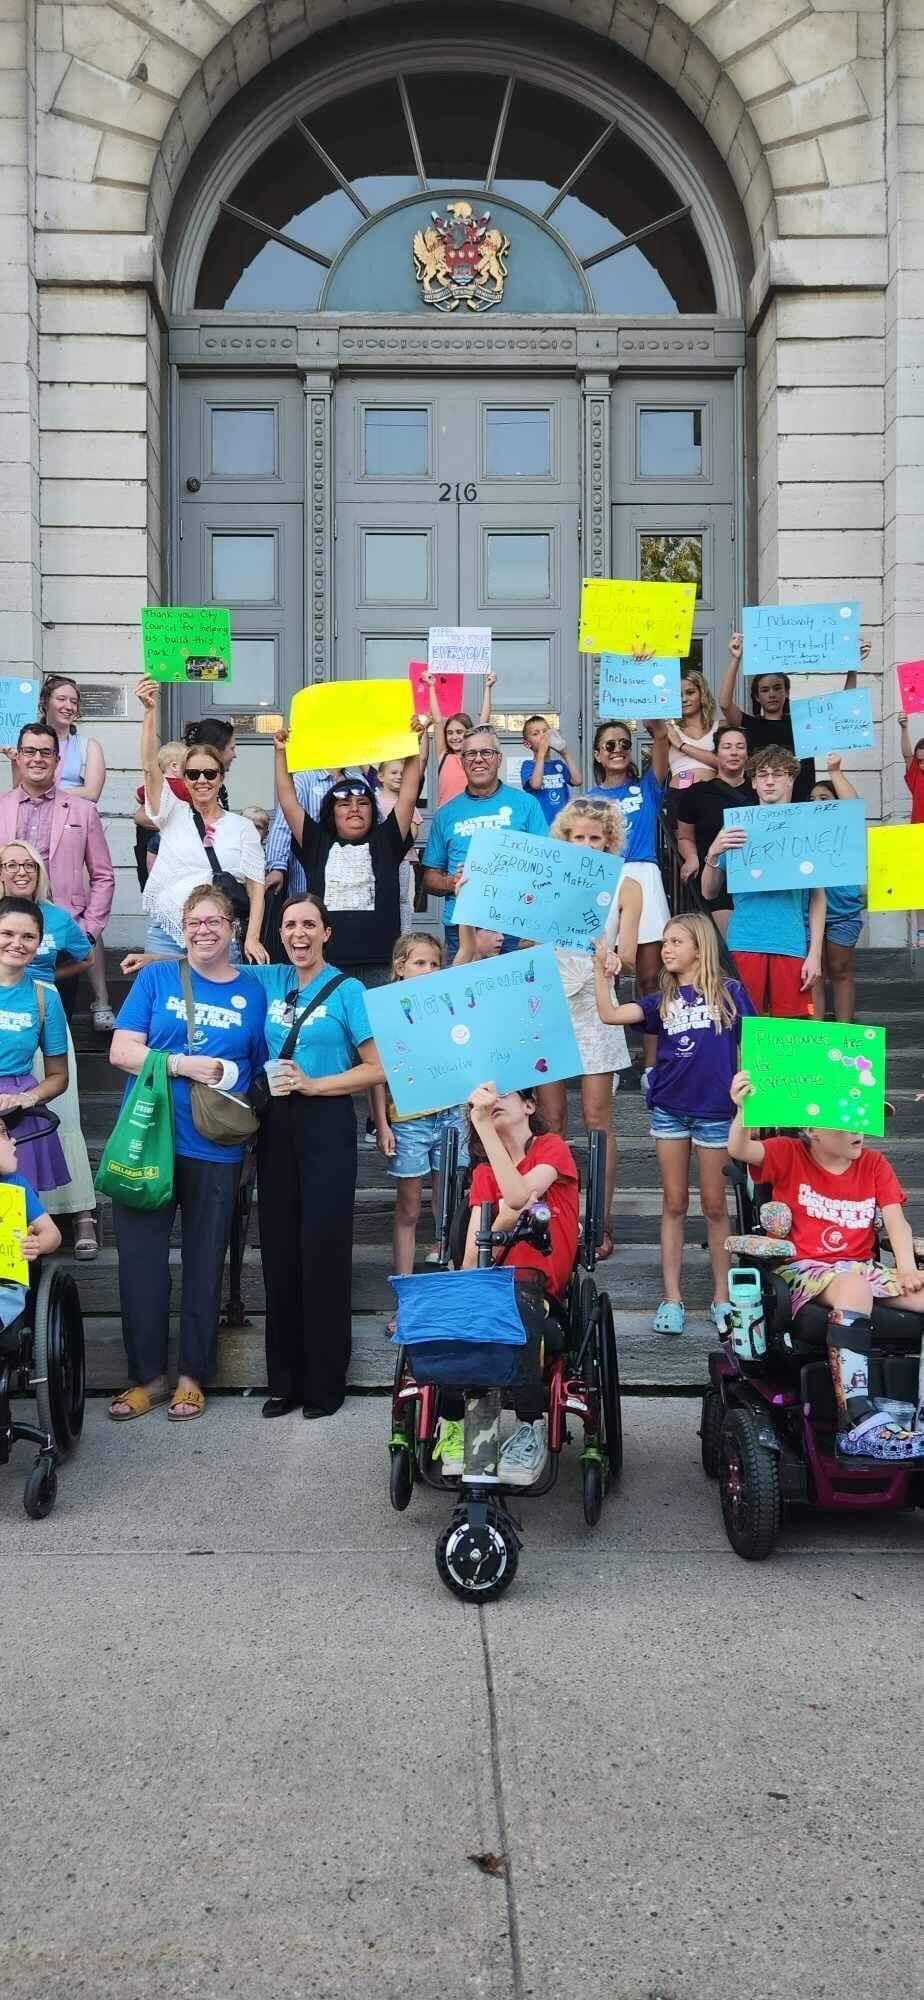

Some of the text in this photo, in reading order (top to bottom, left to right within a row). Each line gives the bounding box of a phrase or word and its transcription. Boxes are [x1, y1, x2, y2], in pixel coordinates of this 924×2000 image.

[439, 482, 477, 502] 216
[144, 609, 218, 623] Thank you City
[145, 621, 230, 636] Council for helping
[164, 635, 189, 645] build
[193, 637, 214, 646] this
[605, 668, 650, 686] Inclusive
[807, 699, 834, 718] Fun
[814, 802, 840, 814] ARE
[498, 833, 563, 864] Inclusive
